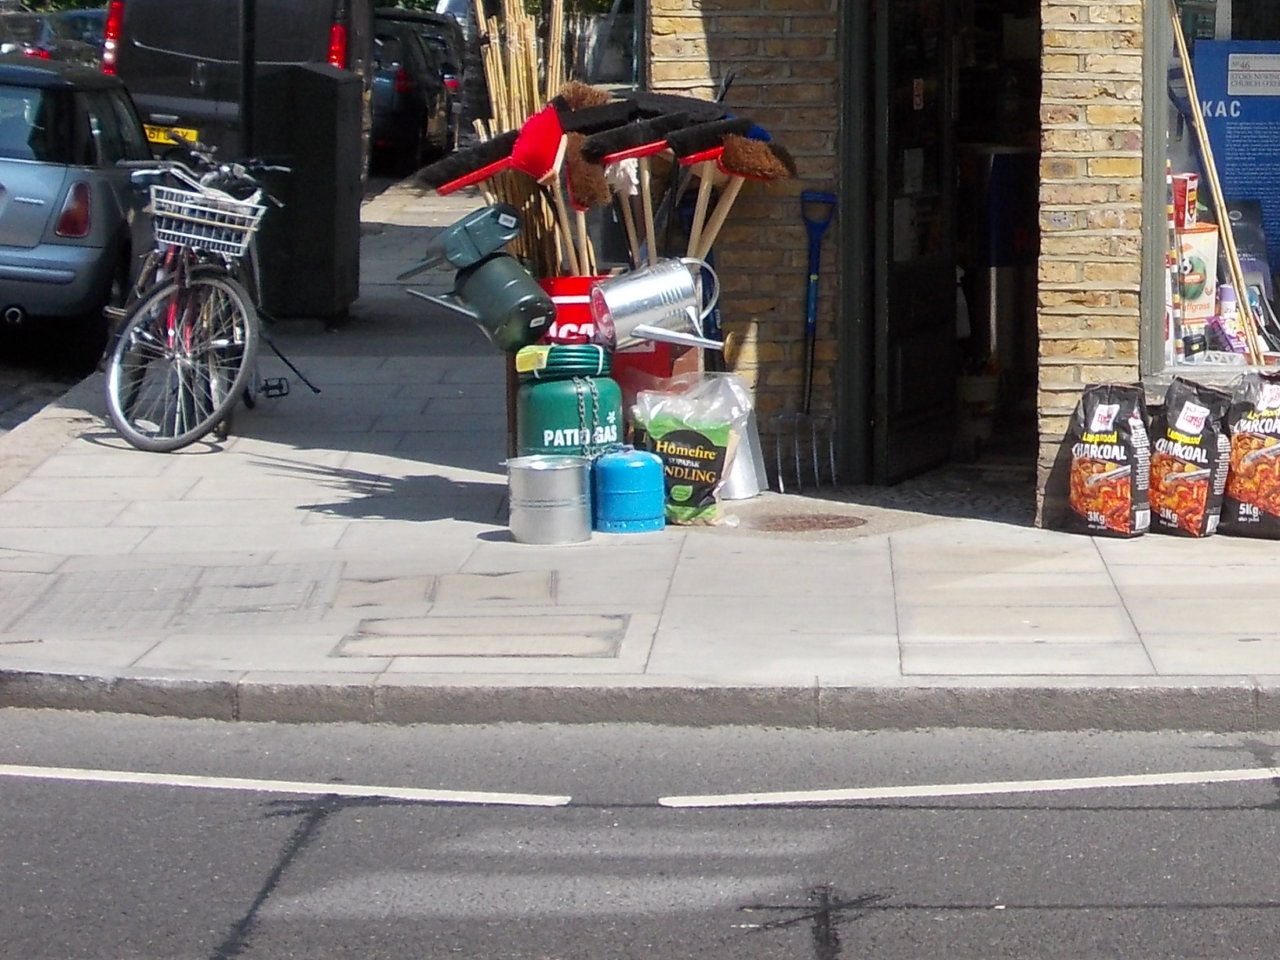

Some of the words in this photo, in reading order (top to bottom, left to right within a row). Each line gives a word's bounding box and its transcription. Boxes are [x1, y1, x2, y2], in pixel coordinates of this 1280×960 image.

[595, 424, 618, 444] GAS
[656, 440, 717, 460] Homefire
[1071, 442, 1128, 461] CHARCOAL
[1155, 438, 1209, 464] CHARCOAL
[664, 465, 717, 484] NDLING
[1087, 511, 1106, 525] 3Kg
[1159, 507, 1178, 523] 3Kg
[1238, 503, 1260, 518] 5Kg
